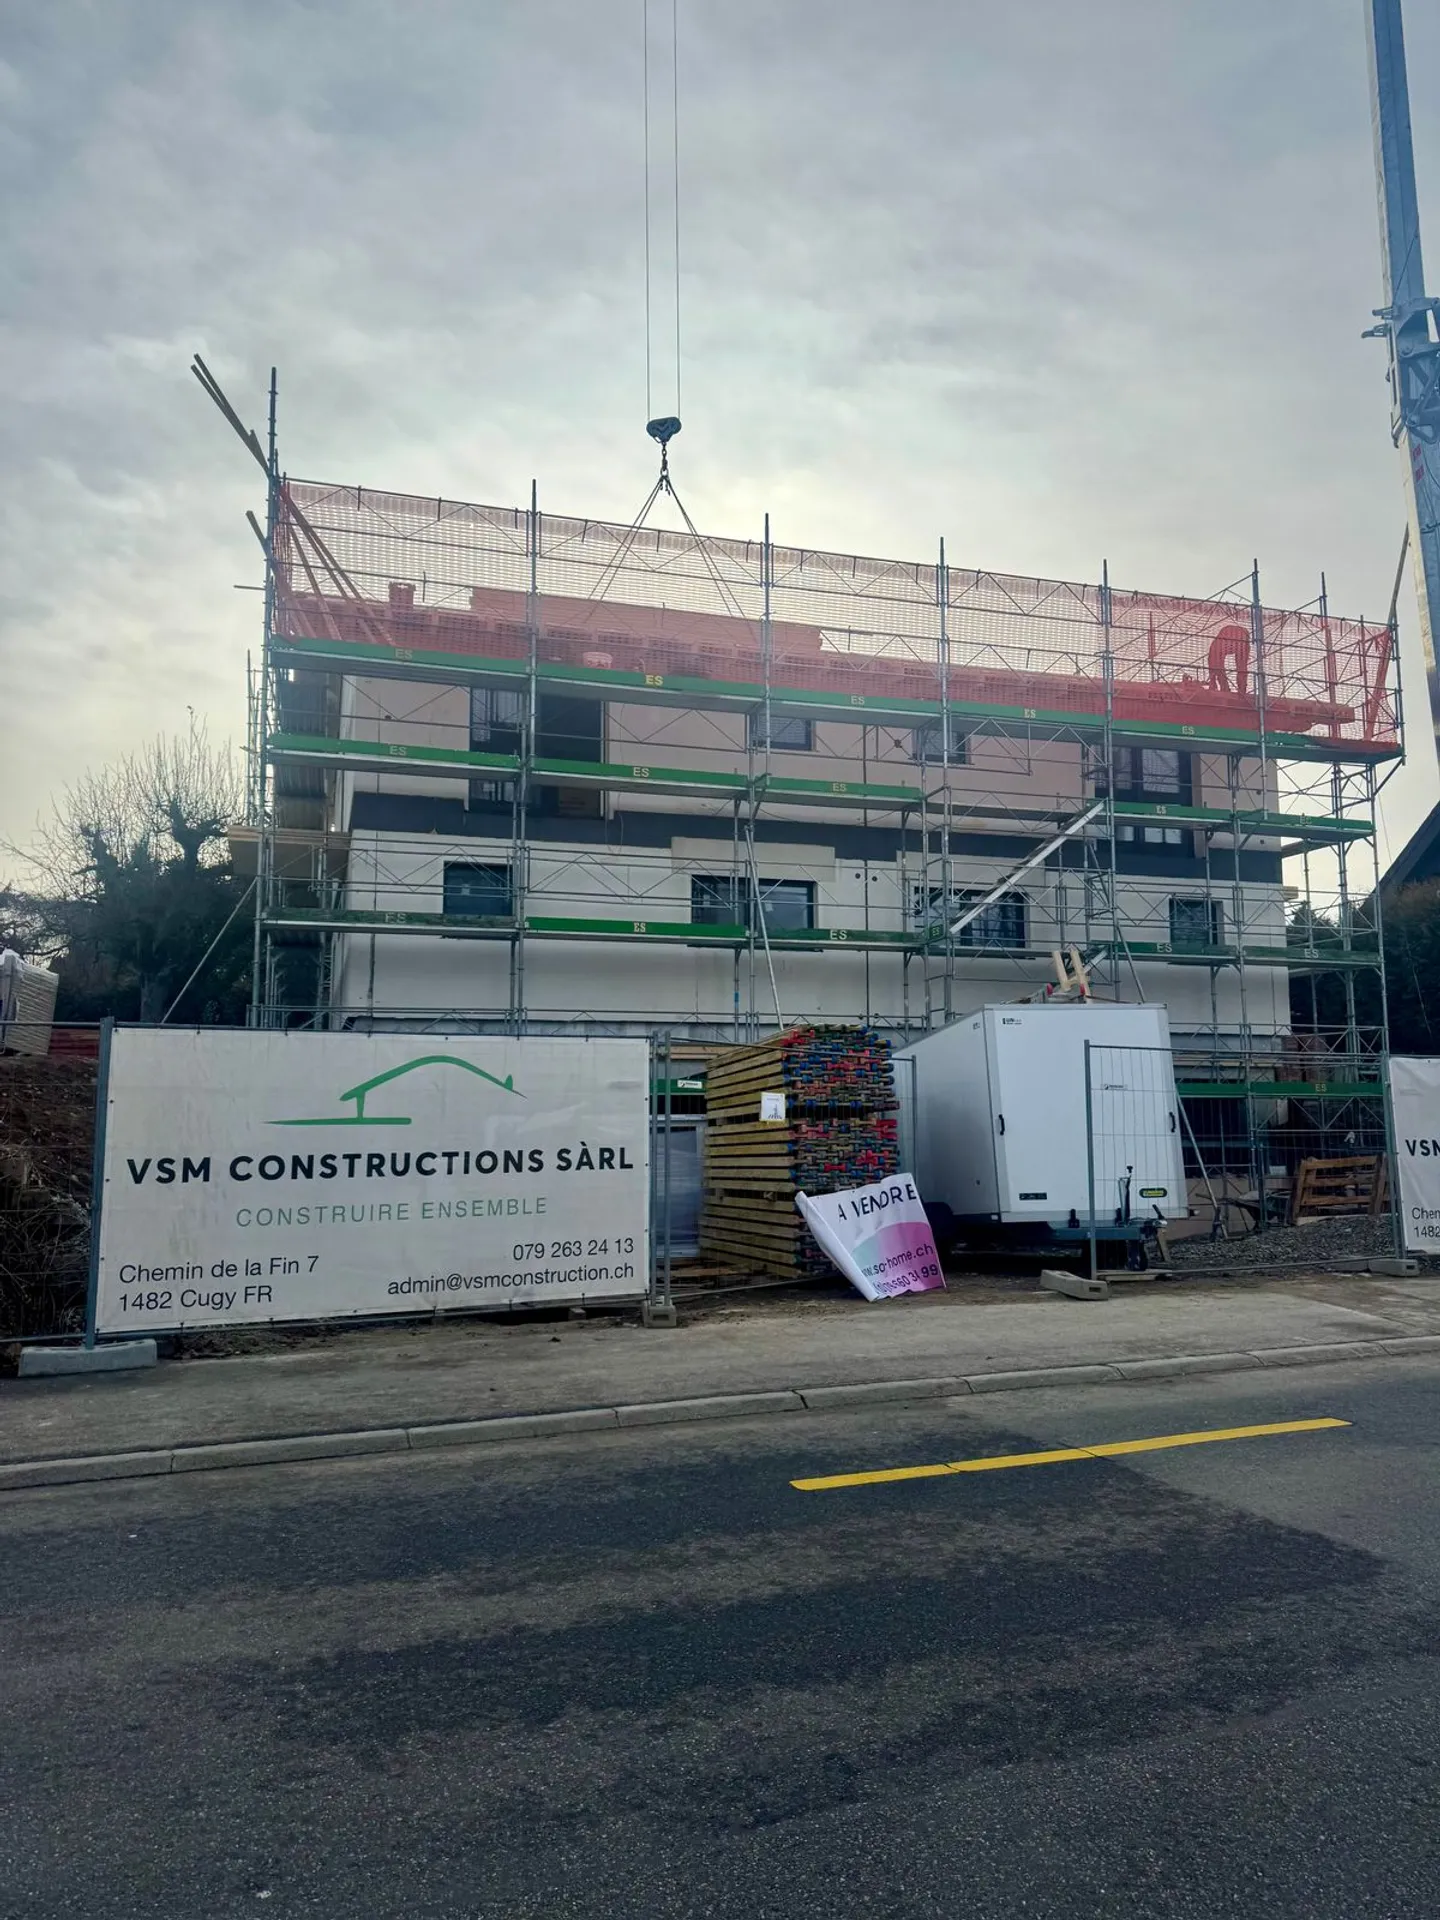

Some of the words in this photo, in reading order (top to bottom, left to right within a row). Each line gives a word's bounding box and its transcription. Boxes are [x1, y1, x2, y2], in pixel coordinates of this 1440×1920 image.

[645, 674, 664, 686] ES
[850, 695, 865, 706] ES
[1024, 708, 1036, 719] ES
[1182, 725, 1195, 735] ES
[389, 745, 407, 756] ES
[633, 766, 650, 778] ES
[832, 781, 847, 792] ES
[1156, 804, 1167, 814] ES
[633, 922, 646, 933] ES
[829, 929, 848, 941] ES
[1156, 942, 1173, 953] ES
[1304, 948, 1319, 959] ES
[1315, 1083, 1327, 1092] ES
[127, 1156, 211, 1185] VSM
[229, 1150, 544, 1181] CONSTRUCTIONS
[556, 1141, 634, 1172] SÀRL
[851, 1183, 917, 1218] VENDRE
[236, 1203, 409, 1227] CONSTRUIRE
[422, 1197, 547, 1219] ENSEMBLE
[513, 1243, 545, 1260] 079
[551, 1241, 582, 1258] 263
[587, 1239, 608, 1256] 24
[614, 1238, 634, 1254] 13
[119, 1262, 203, 1284] Chemin
[211, 1260, 238, 1278] de
[245, 1258, 262, 1276] la
[269, 1257, 299, 1275] Fin
[307, 1255, 320, 1273] 7
[921, 1264, 939, 1278] 99
[387, 1263, 634, 1295] admin@vsmconstruction.ch
[119, 1290, 172, 1312] 1482
[180, 1289, 237, 1310] Cugy
[244, 1285, 273, 1304] FR
